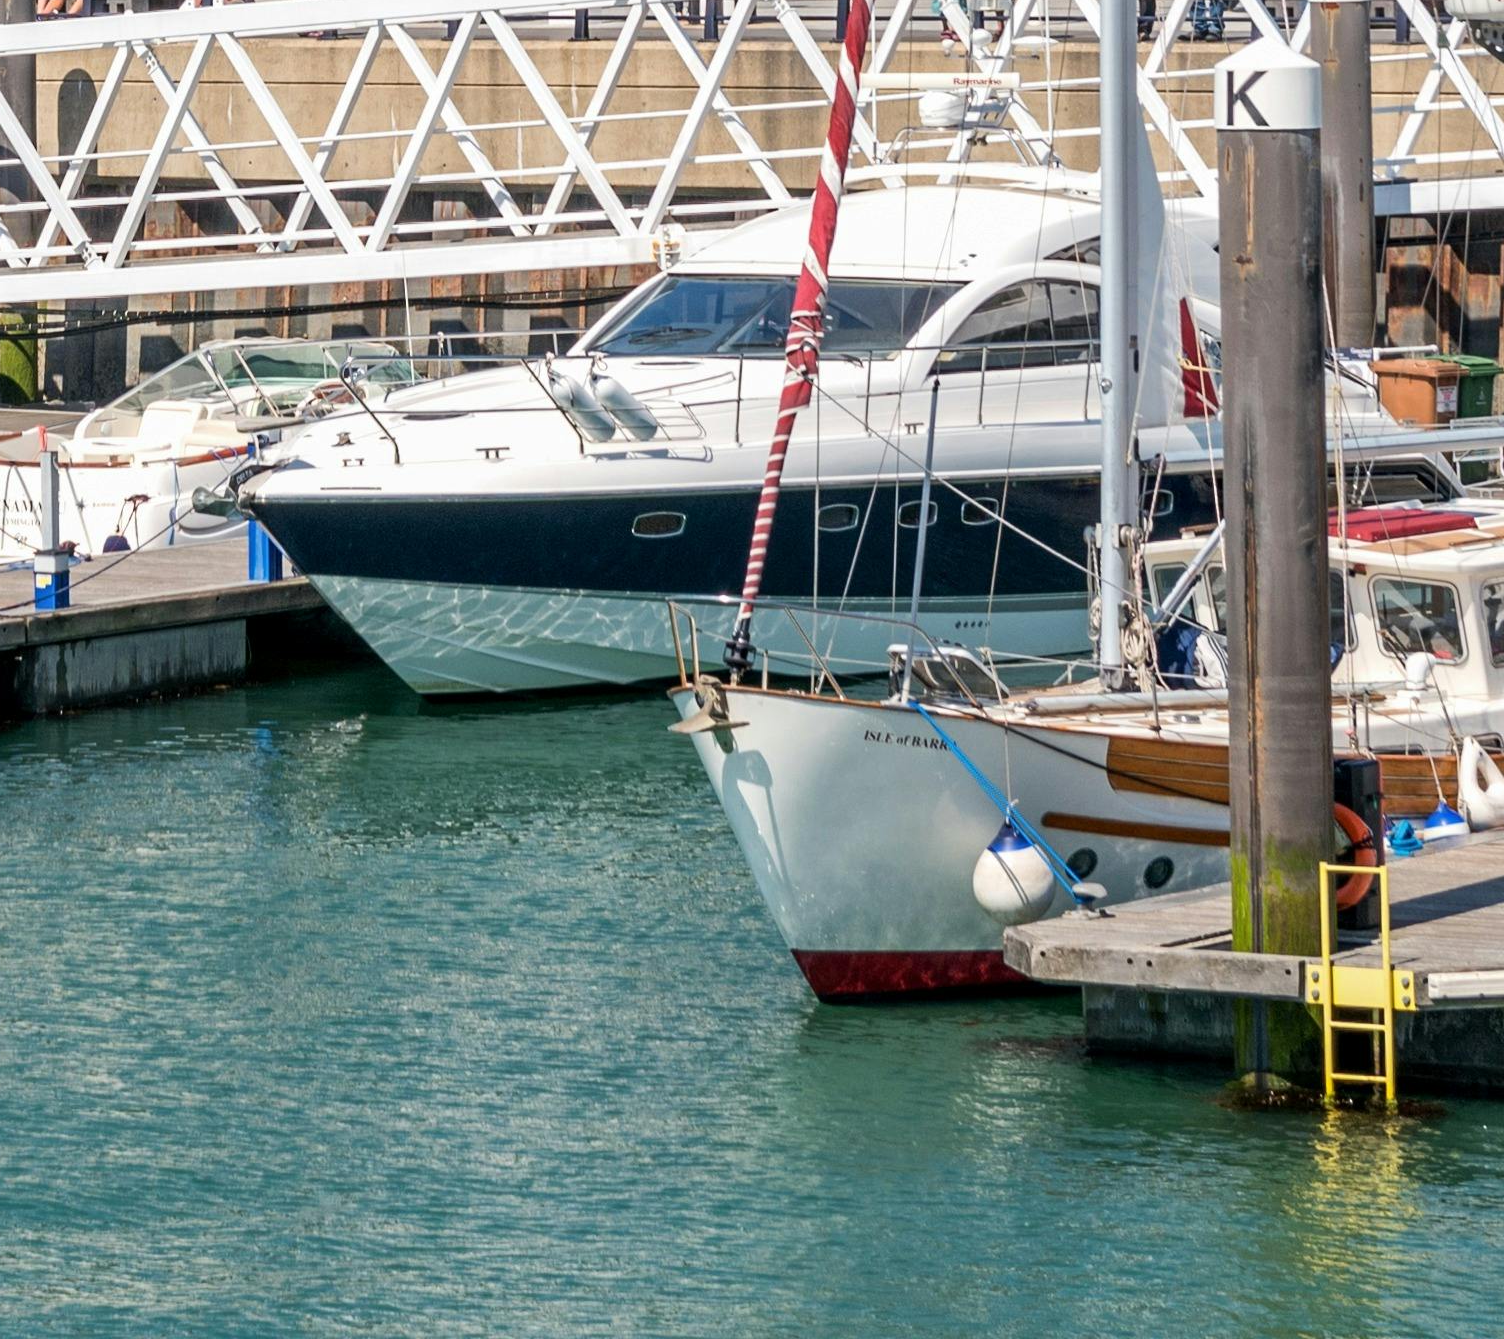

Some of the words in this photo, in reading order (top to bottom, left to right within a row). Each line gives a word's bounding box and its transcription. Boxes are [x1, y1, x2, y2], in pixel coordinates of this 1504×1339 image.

[1226, 69, 1271, 127] K
[864, 729, 894, 744] ISLE
[896, 735, 910, 746] of
